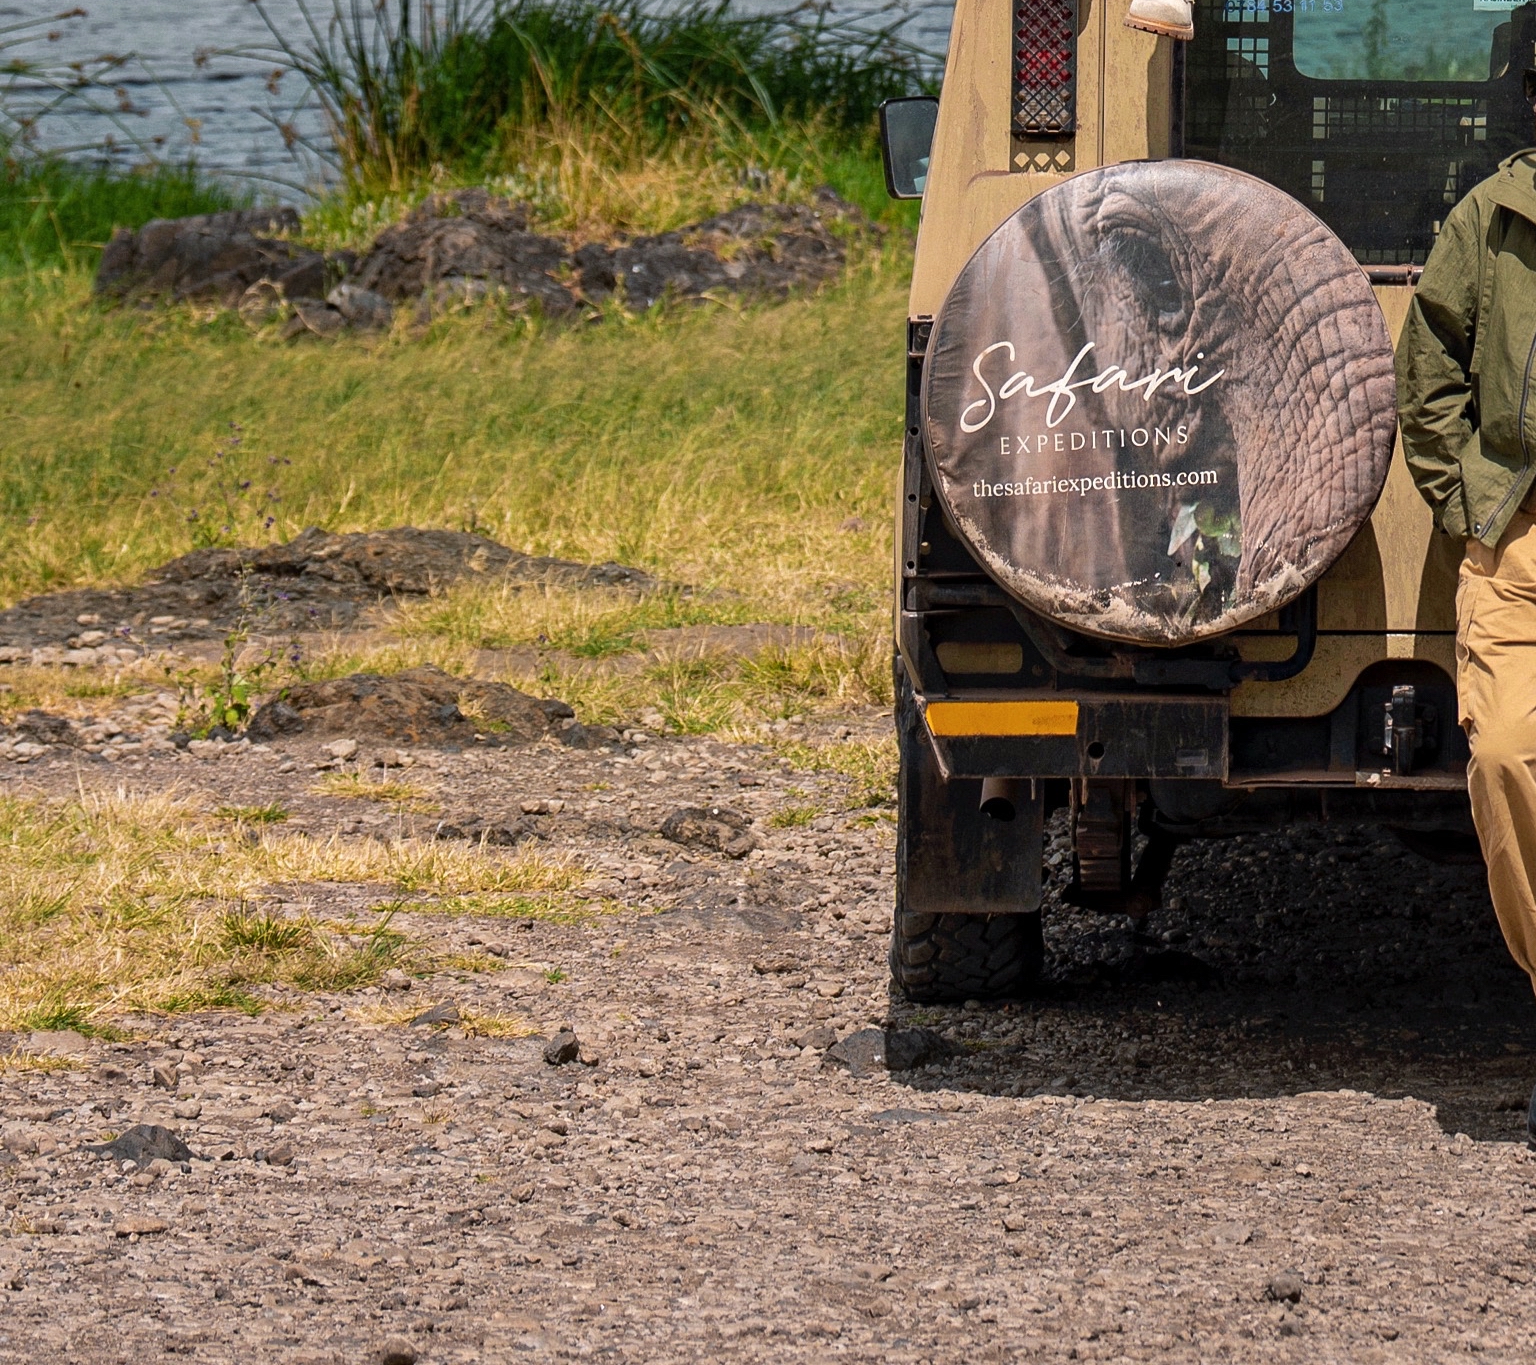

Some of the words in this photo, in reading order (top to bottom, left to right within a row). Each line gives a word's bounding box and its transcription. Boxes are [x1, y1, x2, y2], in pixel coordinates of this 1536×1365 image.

[1273, 0, 1292, 12] 53
[1300, 0, 1316, 12] 11
[960, 341, 1225, 433] Safari
[1000, 425, 1189, 455] EXPEDITIONS
[972, 469, 1219, 498] thesafariexpeditions.com
